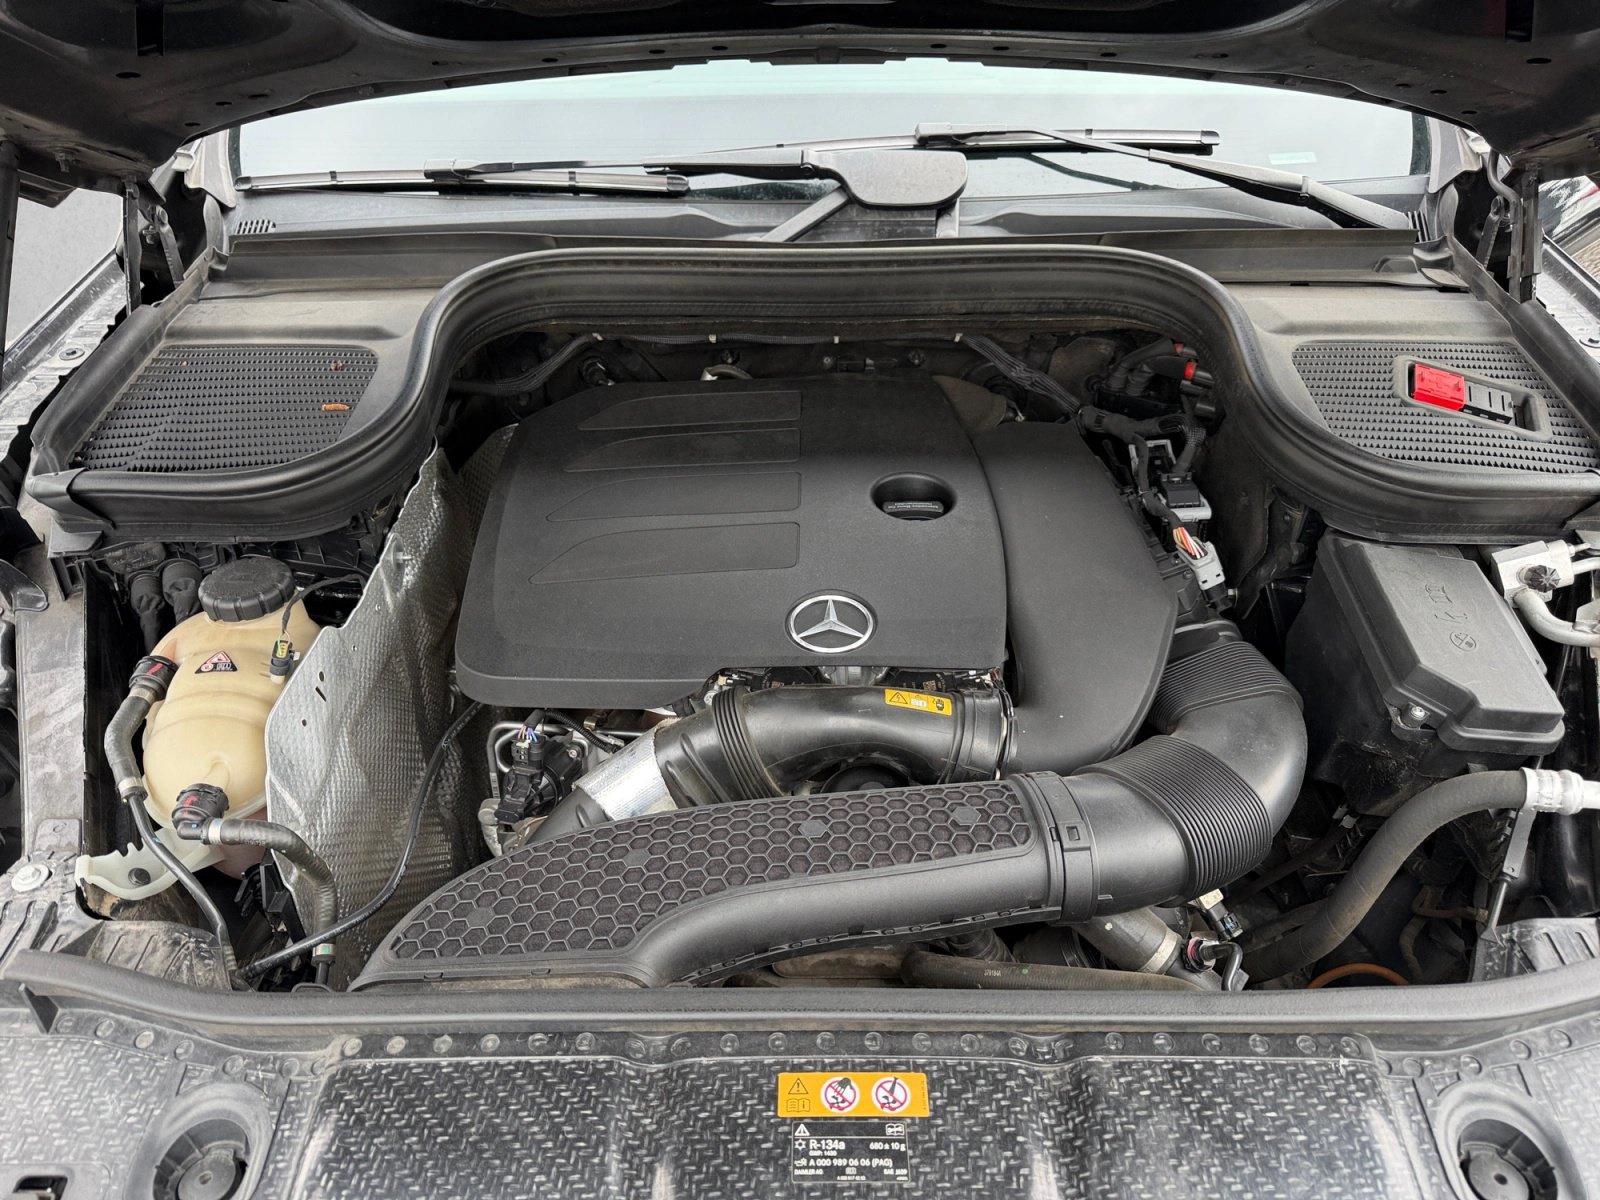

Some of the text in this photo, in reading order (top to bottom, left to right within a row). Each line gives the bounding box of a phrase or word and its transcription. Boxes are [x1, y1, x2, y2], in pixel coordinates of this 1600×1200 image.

[809, 1139, 846, 1150] R-134a
[869, 1141, 884, 1150] 680
[890, 1141, 900, 1150] 10
[900, 1143, 906, 1152] g
[809, 1158, 893, 1168] A 000 989 06 06 (PAG)
